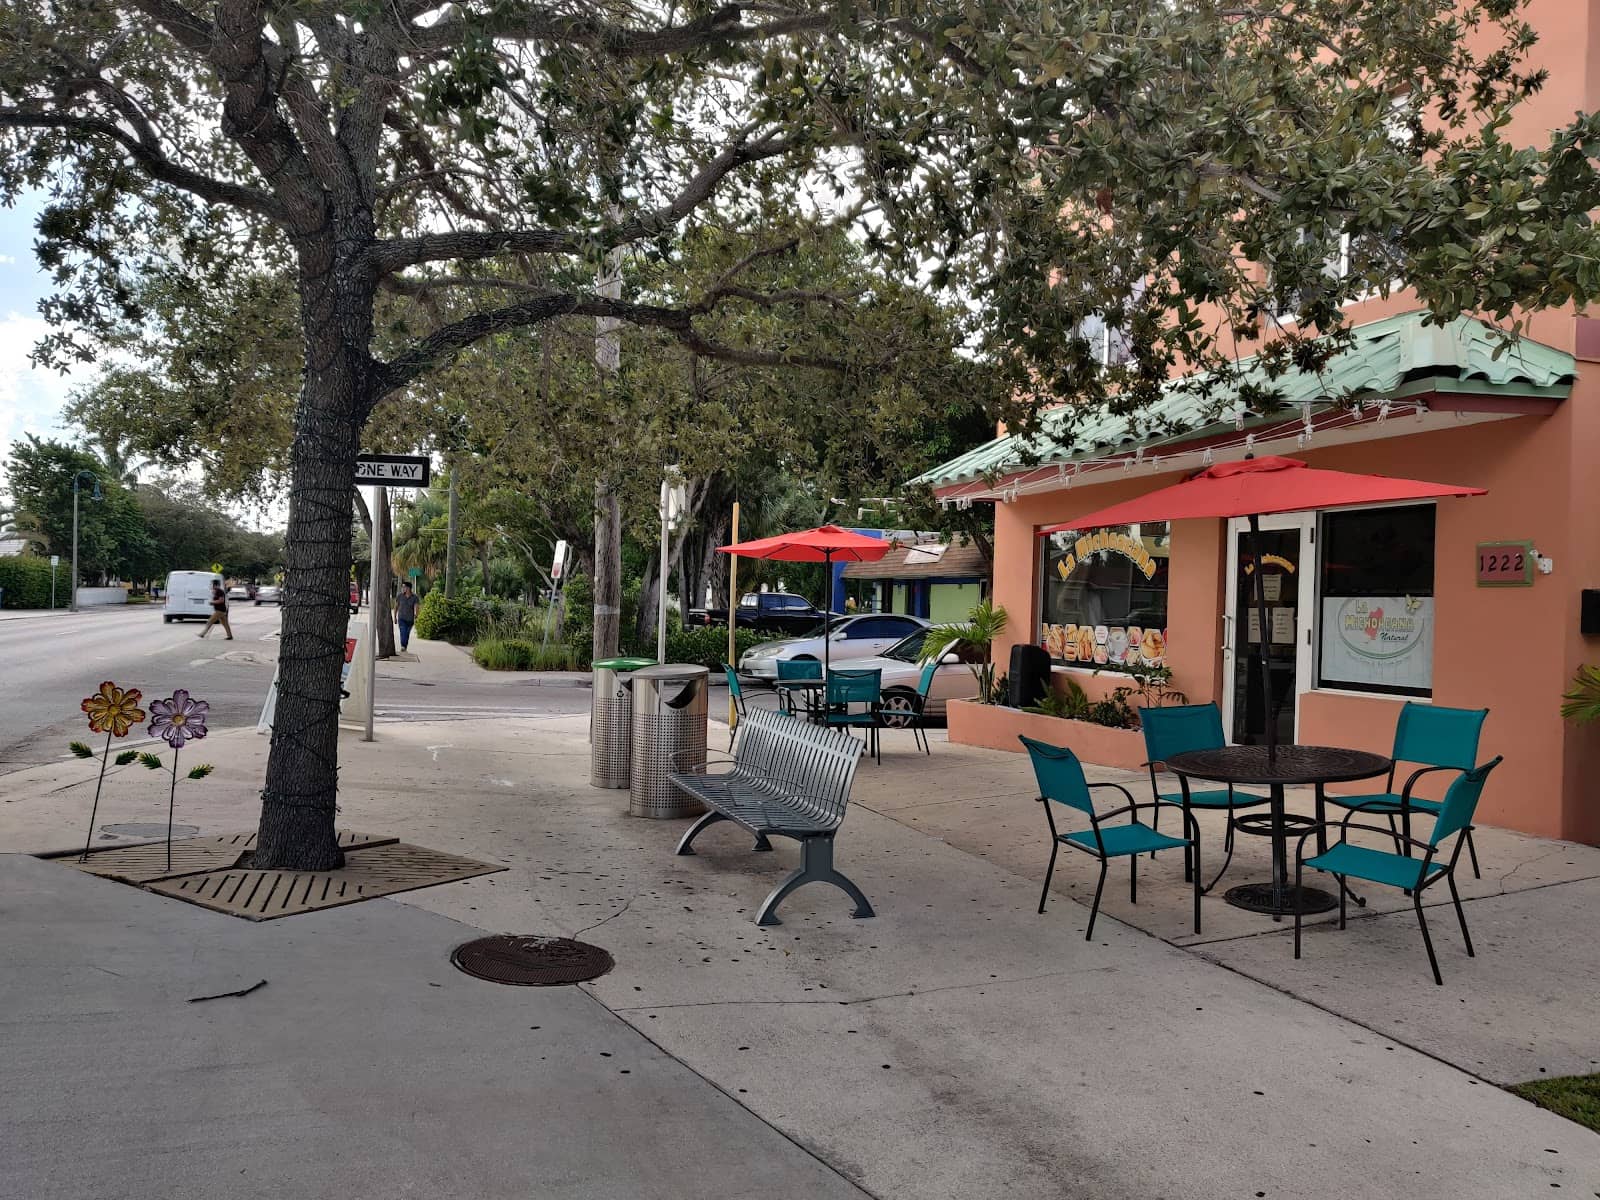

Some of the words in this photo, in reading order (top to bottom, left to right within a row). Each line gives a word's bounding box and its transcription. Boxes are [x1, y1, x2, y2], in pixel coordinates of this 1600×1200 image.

[356, 463, 385, 477] ONE
[391, 464, 418, 478] WAY
[1057, 552, 1076, 582] La
[1480, 554, 1524, 573] 1222
